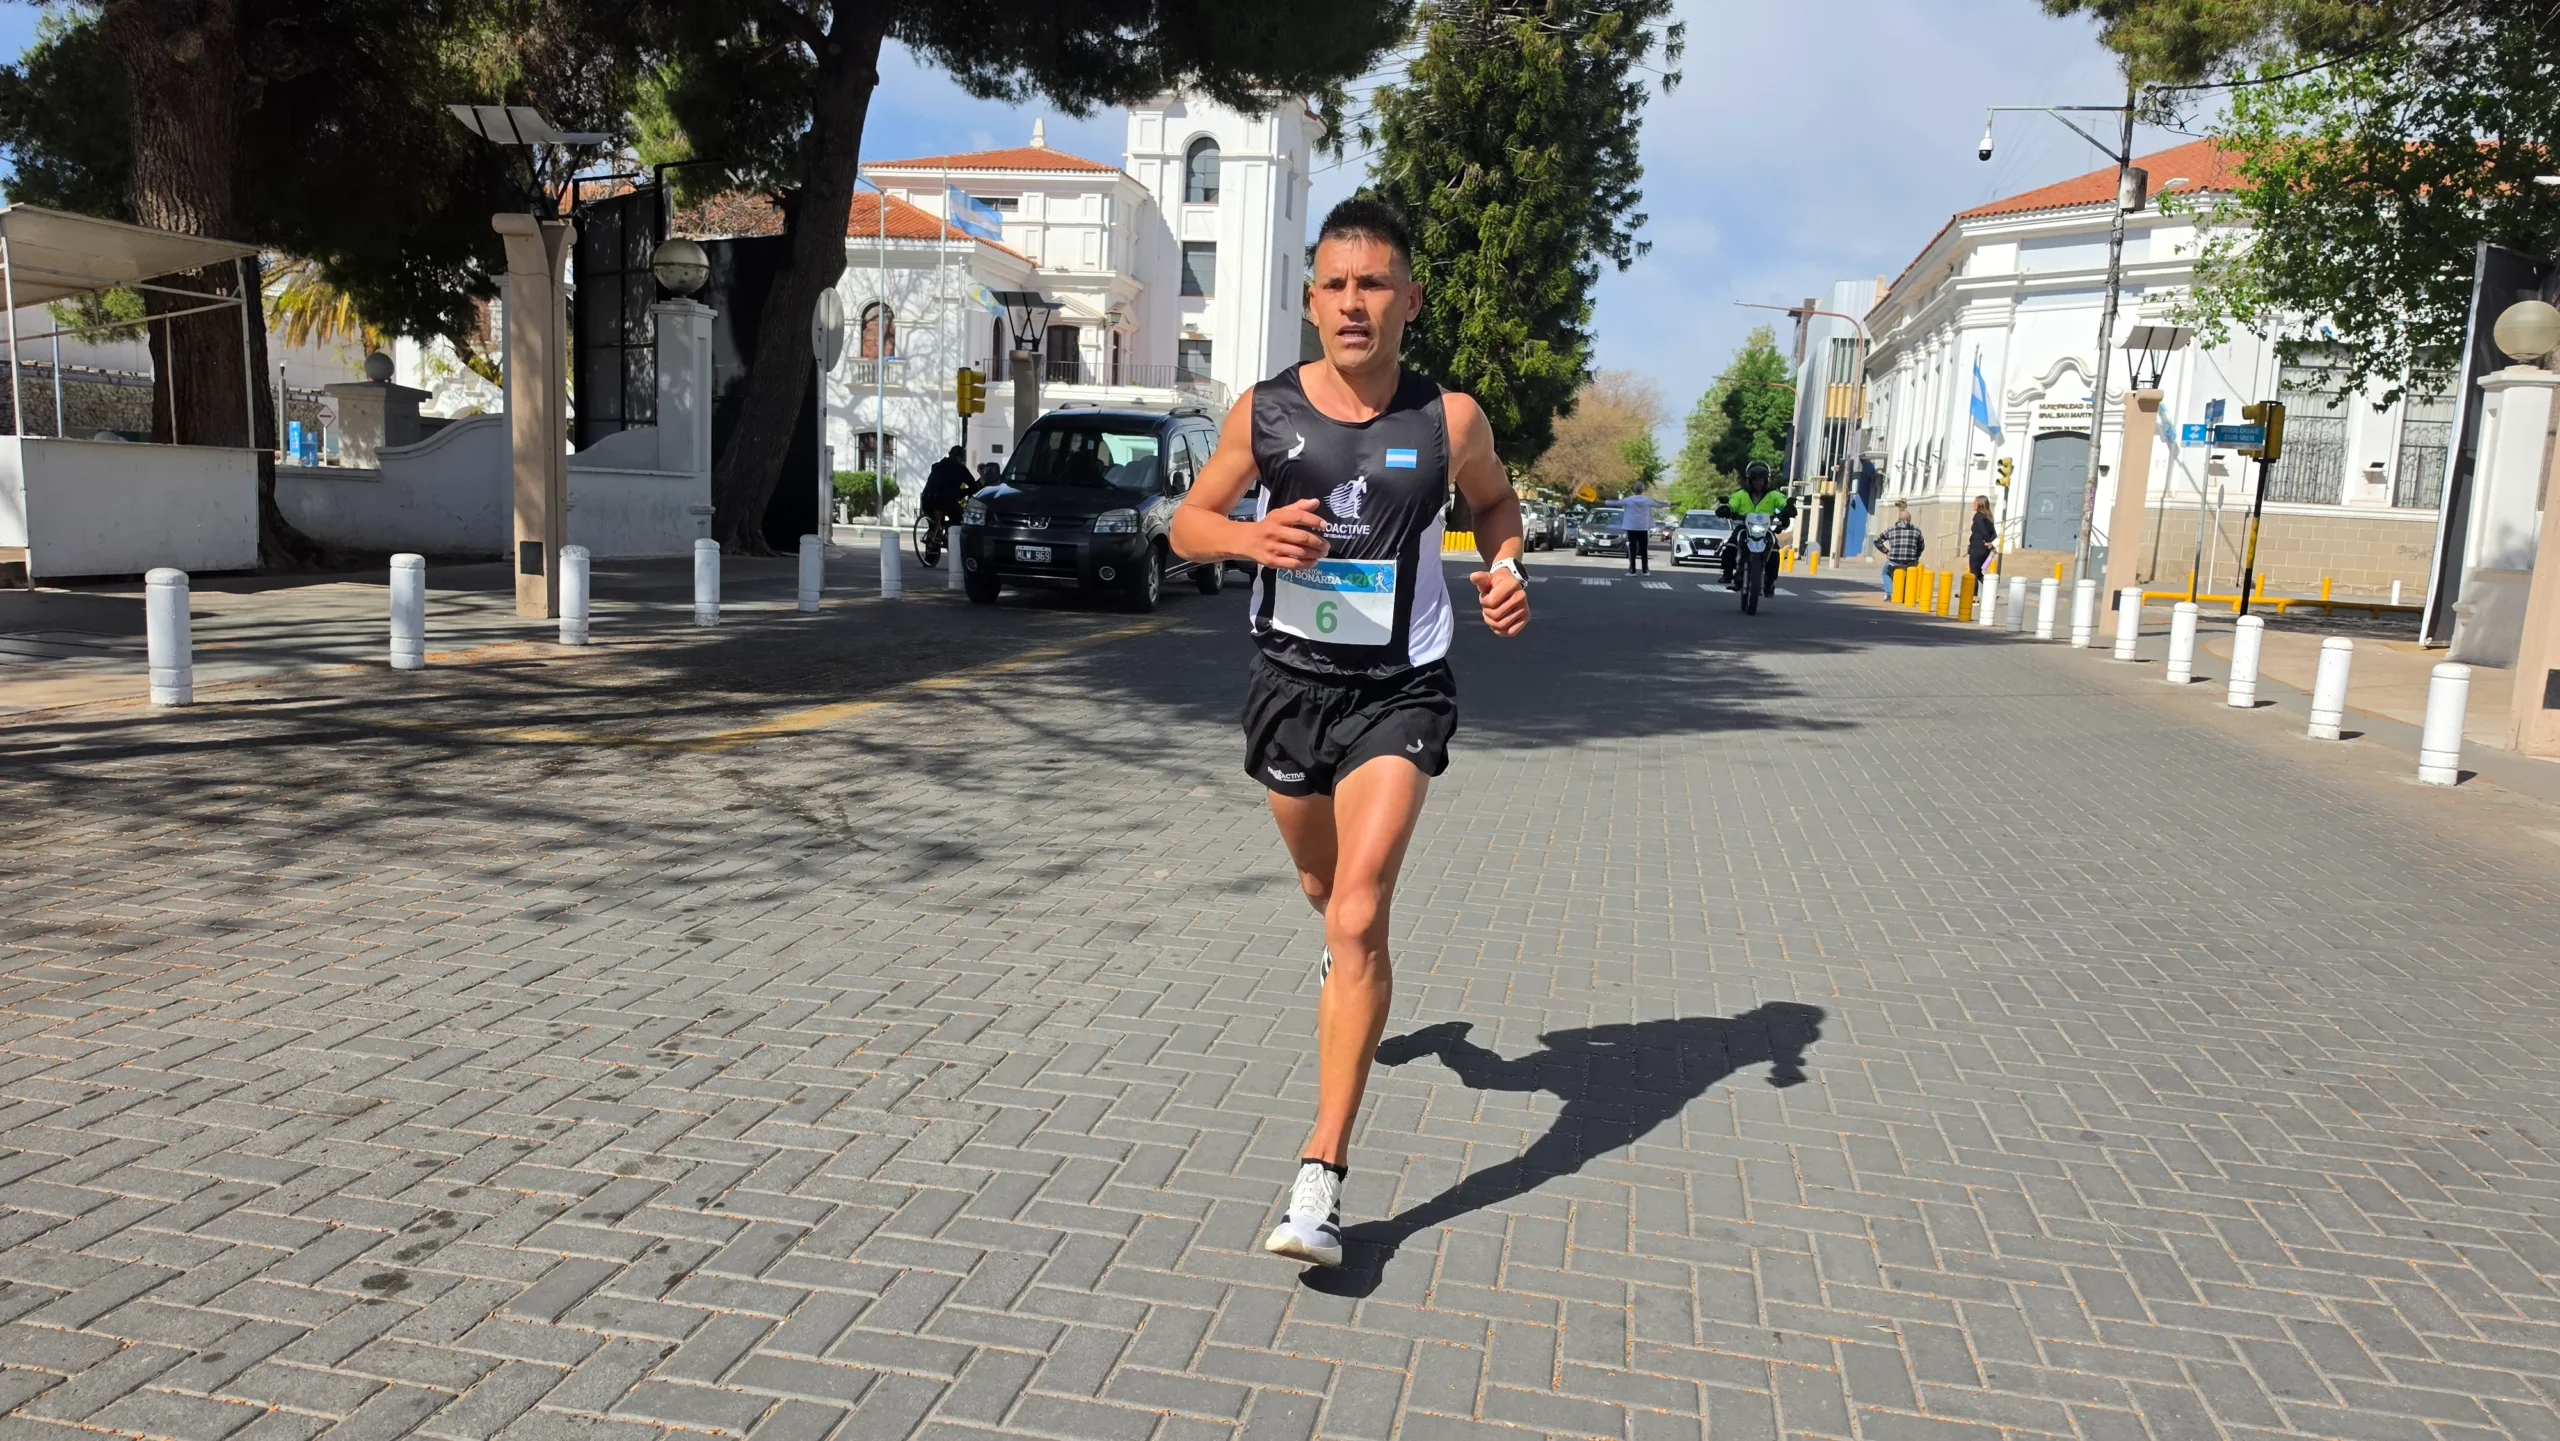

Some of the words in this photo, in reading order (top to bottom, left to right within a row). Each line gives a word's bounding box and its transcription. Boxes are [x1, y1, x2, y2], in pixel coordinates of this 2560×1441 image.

[1312, 522, 1370, 535] OACTIVE
[1018, 550, 1032, 560] MLW
[1035, 551, 1050, 561] 969
[1295, 570, 1342, 585] BONARDA
[1316, 601, 1338, 634] 6
